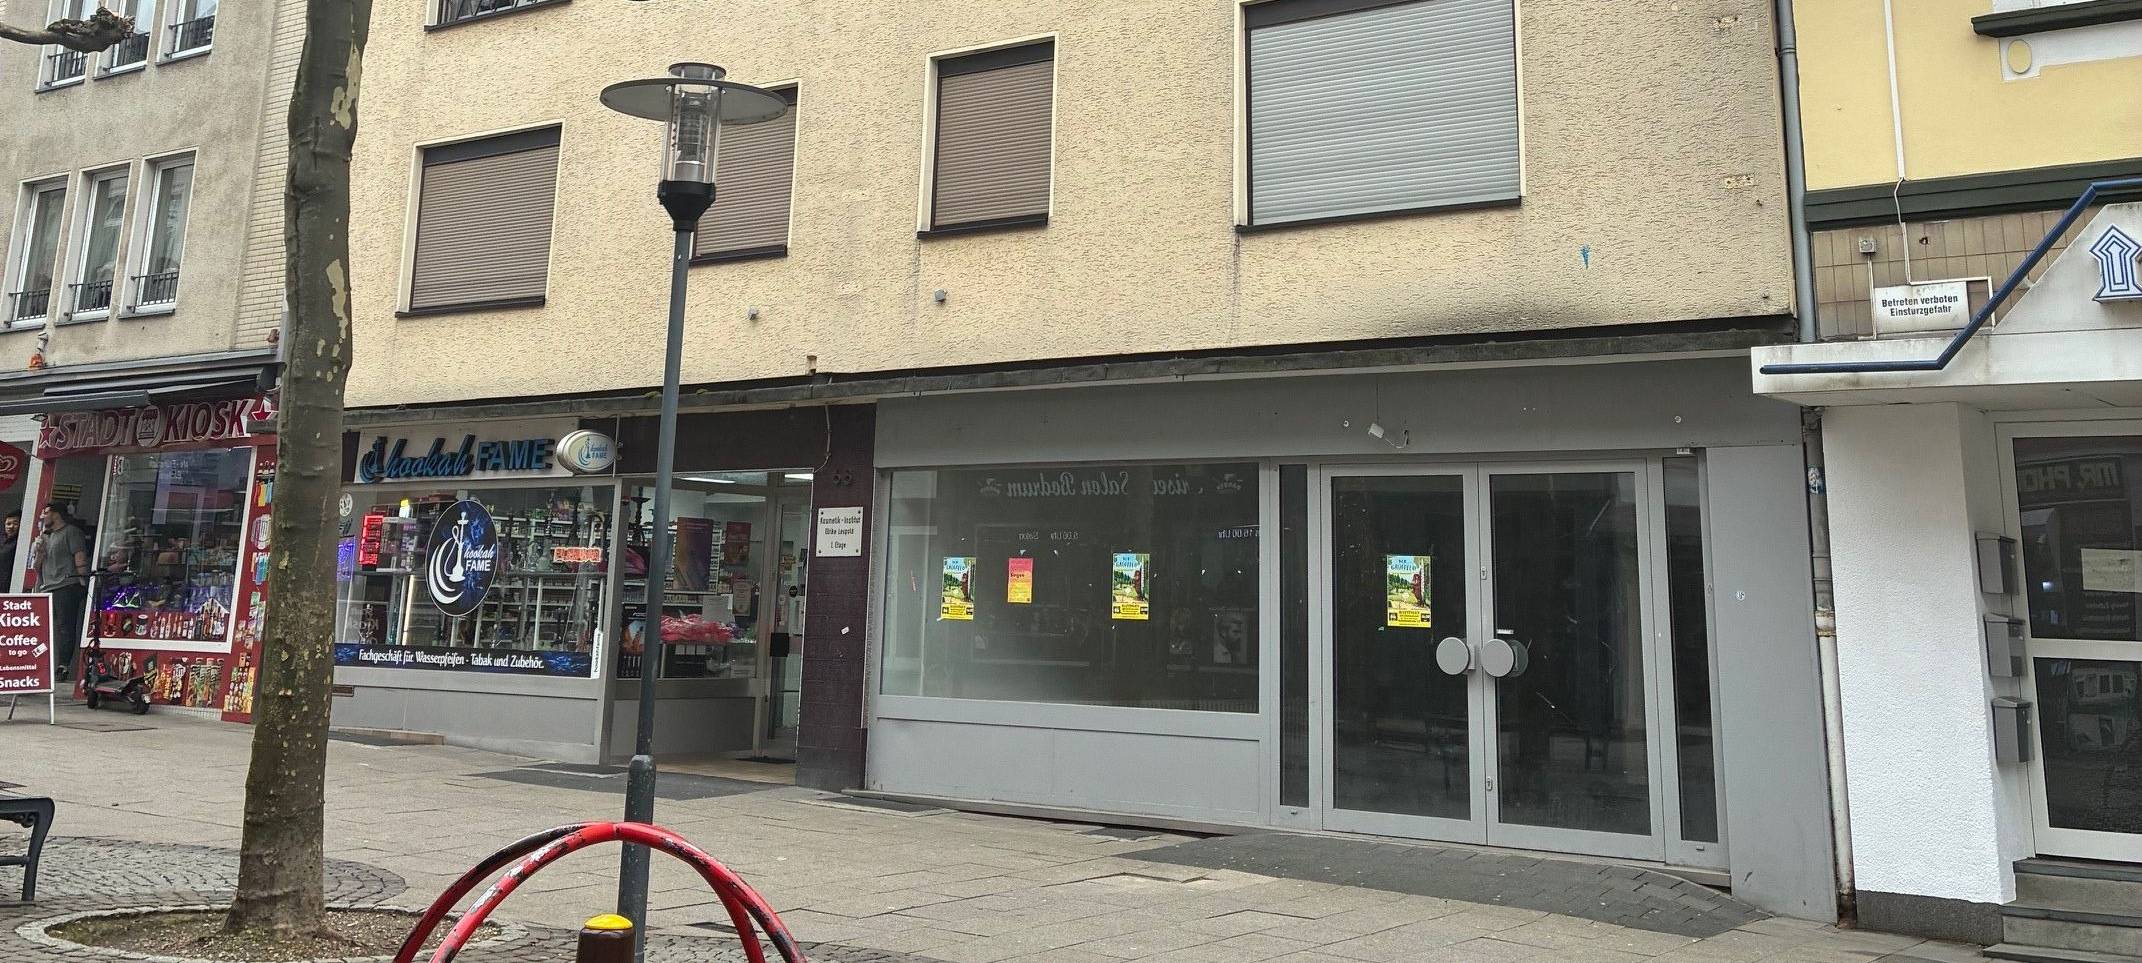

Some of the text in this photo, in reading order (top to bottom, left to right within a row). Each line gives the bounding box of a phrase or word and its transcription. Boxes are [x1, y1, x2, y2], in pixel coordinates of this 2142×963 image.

[1881, 295, 1958, 308] Betreten verboten
[1890, 305, 1952, 316] Einsturzgefahr
[55, 408, 139, 450] STADT
[163, 399, 256, 443] KIOSK
[384, 434, 555, 478] hookah FAME
[464, 543, 496, 559] hookah
[465, 559, 491, 572] FAME
[3, 600, 32, 610] Stadt
[0, 612, 41, 627] Kiosk
[0, 634, 38, 646] Coffee
[358, 649, 402, 664] Fachgeschäft
[402, 651, 413, 664] für
[415, 651, 465, 668] Wasserpfeifen
[470, 653, 492, 667] Tabak
[493, 655, 509, 667] und
[0, 676, 40, 688] Snacks
